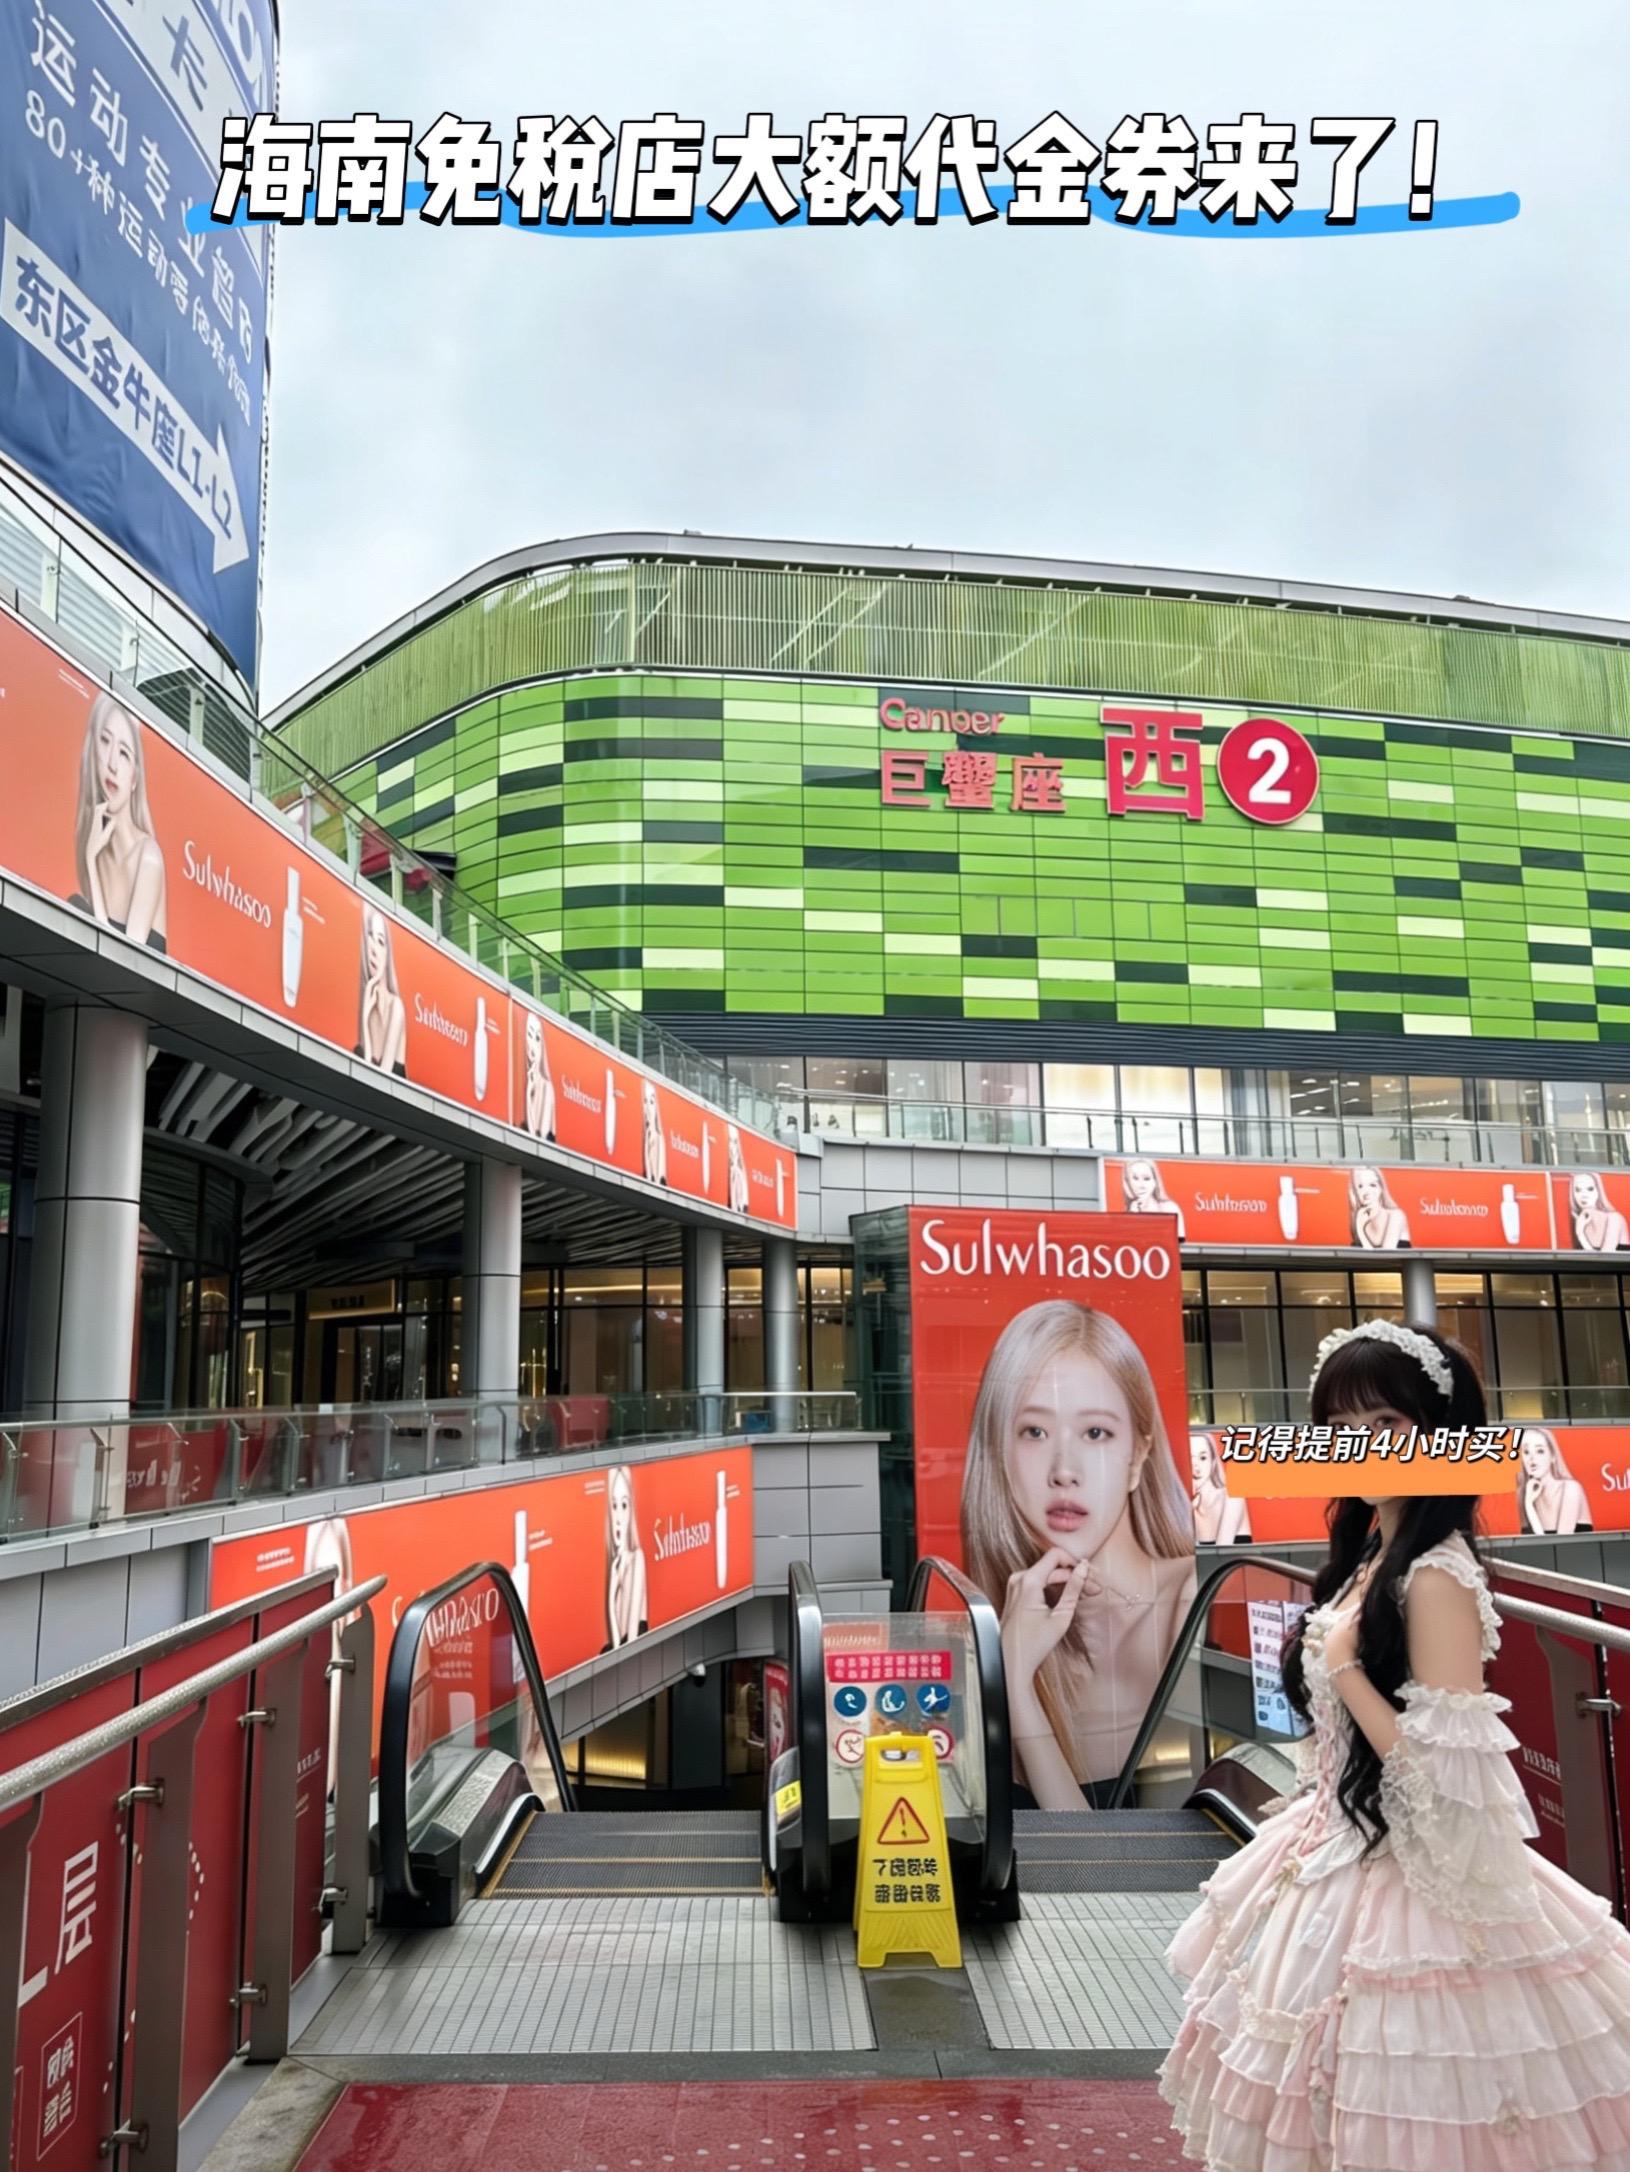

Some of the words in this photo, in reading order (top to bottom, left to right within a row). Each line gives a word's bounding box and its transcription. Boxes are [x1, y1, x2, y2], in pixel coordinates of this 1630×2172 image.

[1101, 706, 1205, 821] 西
[1247, 736, 1292, 805] 2
[920, 1218, 1171, 1280] Sulwhasoo
